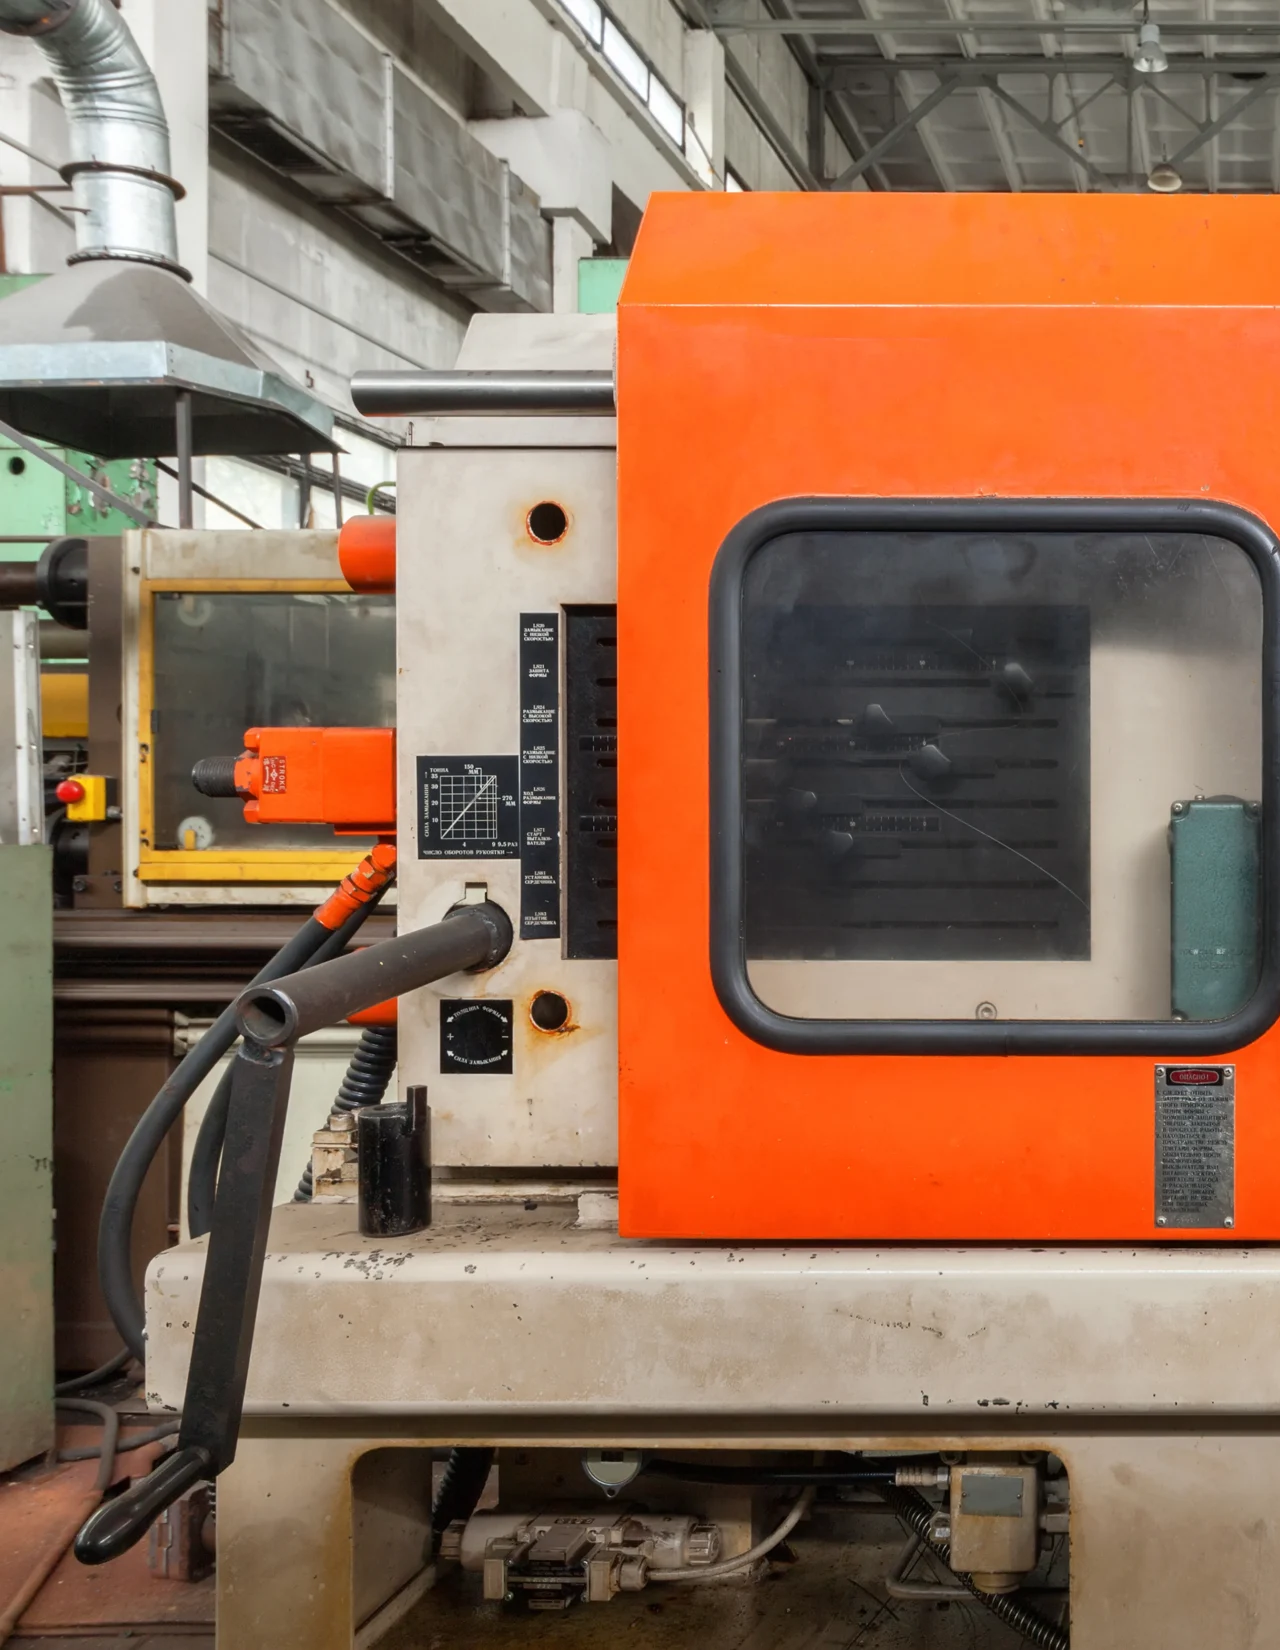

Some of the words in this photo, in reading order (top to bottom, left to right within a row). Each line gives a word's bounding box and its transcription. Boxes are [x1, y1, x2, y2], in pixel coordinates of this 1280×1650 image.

[482, 1006, 501, 1018] ФОРМЫ
[454, 1055, 468, 1064] СИЛА
[469, 1055, 502, 1065] ЗАМЫКАНИЯ
